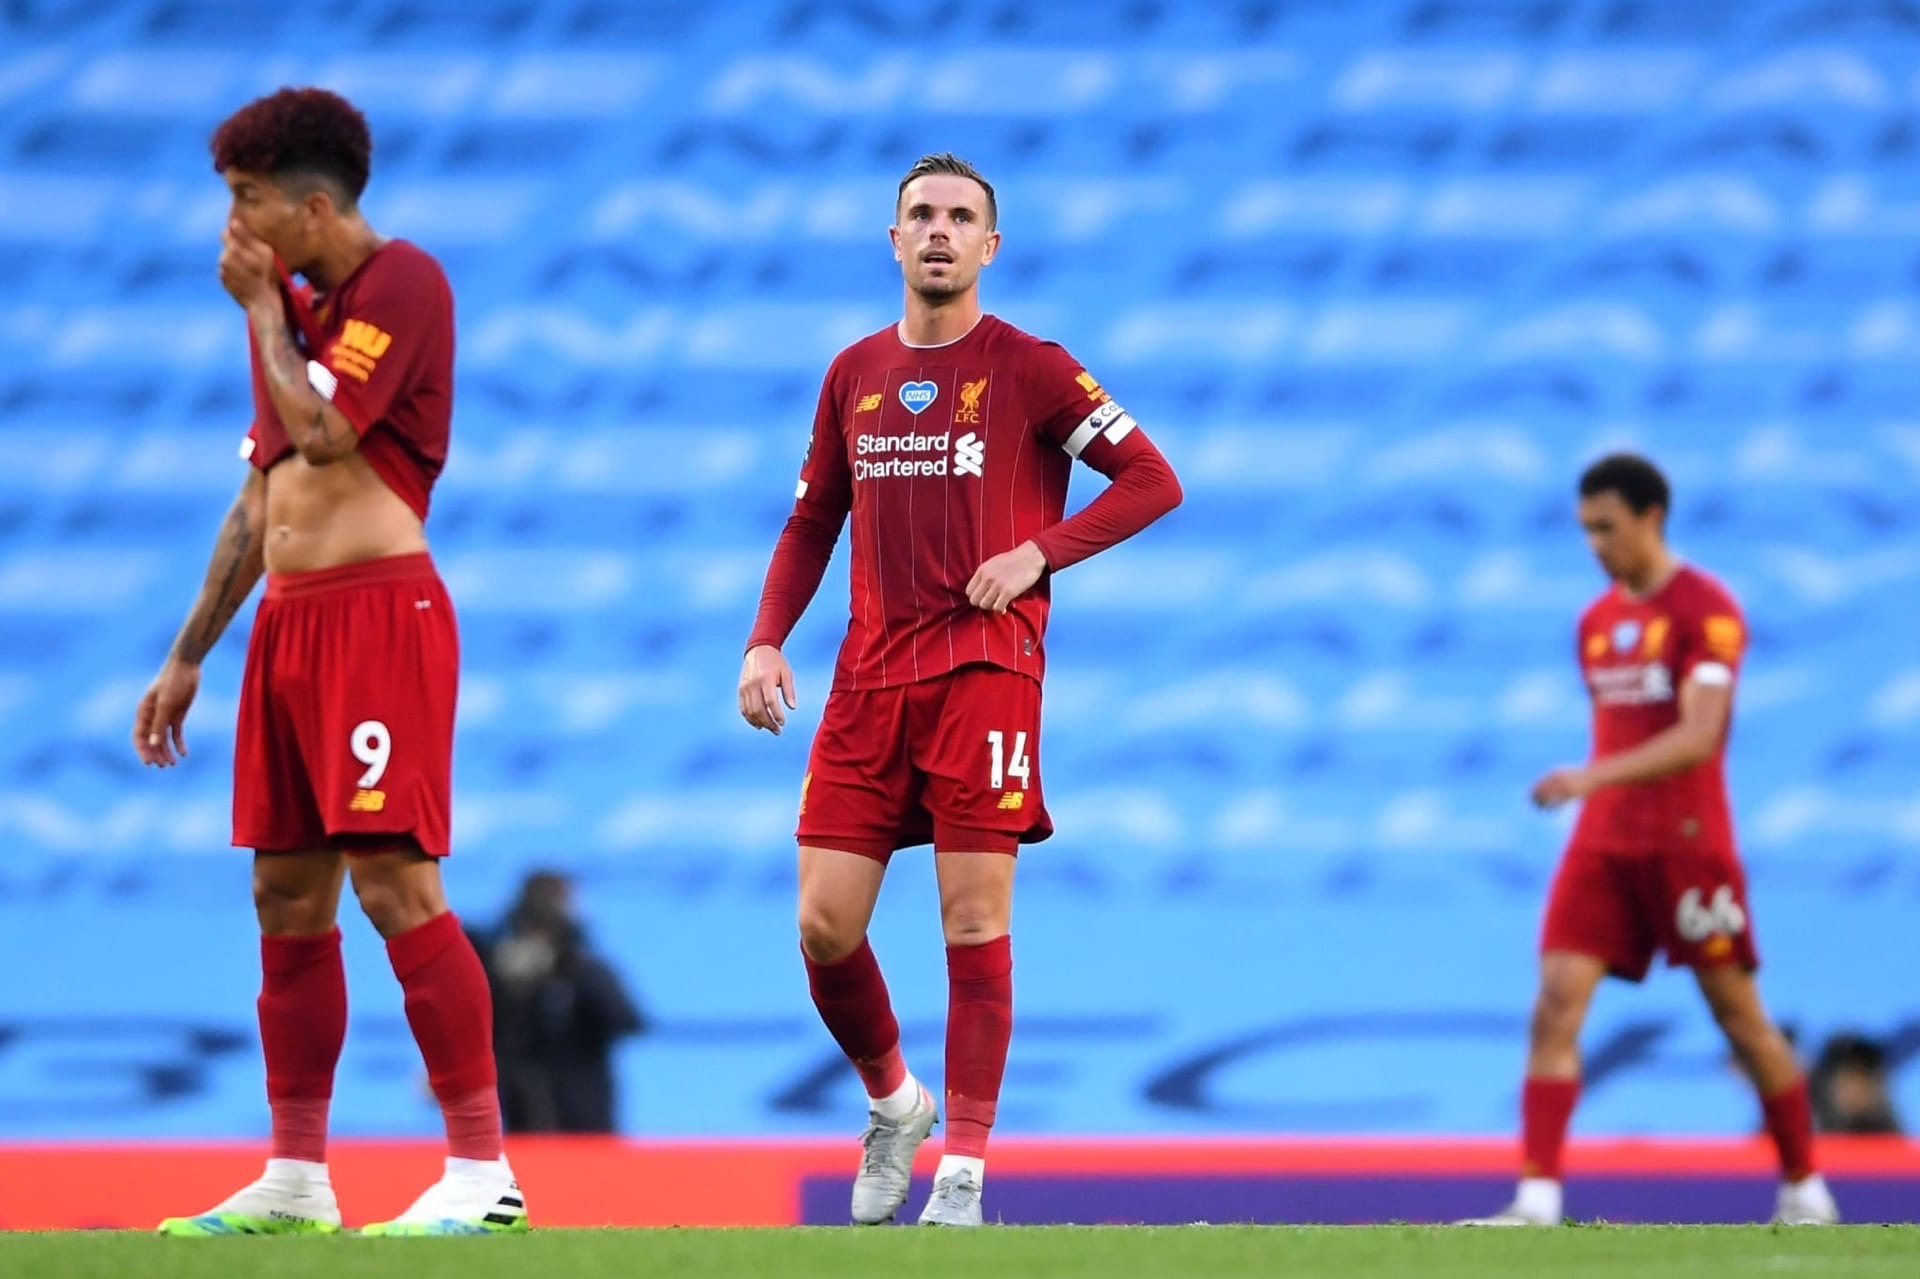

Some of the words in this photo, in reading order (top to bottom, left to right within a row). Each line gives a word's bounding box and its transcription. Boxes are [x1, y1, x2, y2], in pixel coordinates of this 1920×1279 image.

[906, 391, 929, 401] NHS
[954, 413, 979, 424] LFC
[857, 431, 949, 455] Standard
[854, 455, 948, 481] Chartered
[350, 720, 392, 789] 9
[988, 730, 1030, 790] 14
[1676, 885, 1746, 942] 66
